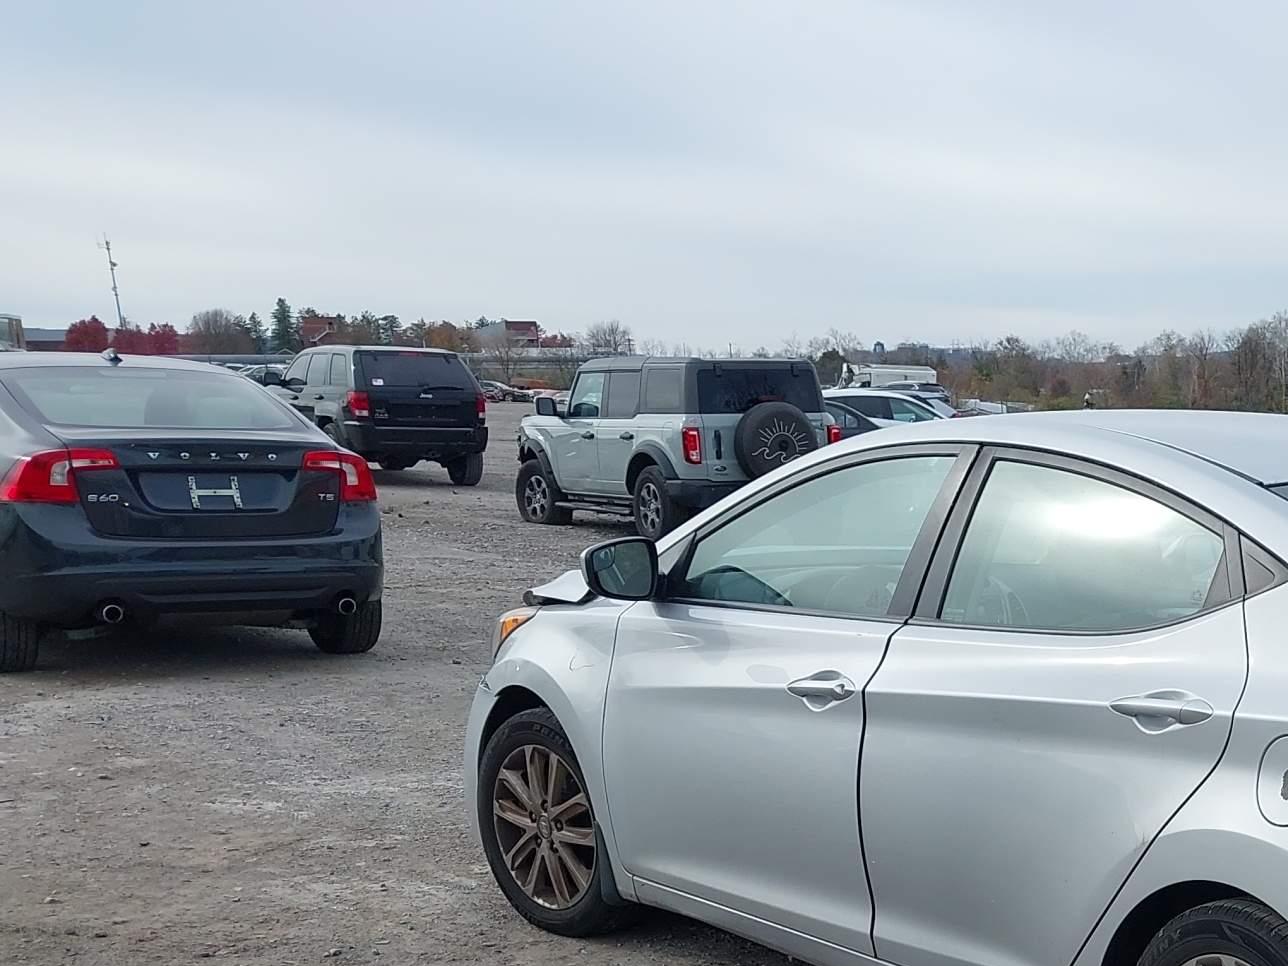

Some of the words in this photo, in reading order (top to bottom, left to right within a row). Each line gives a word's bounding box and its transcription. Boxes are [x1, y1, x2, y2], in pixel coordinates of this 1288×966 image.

[147, 452, 277, 461] VOLVO
[87, 494, 119, 502] S60
[318, 493, 335, 501] T5
